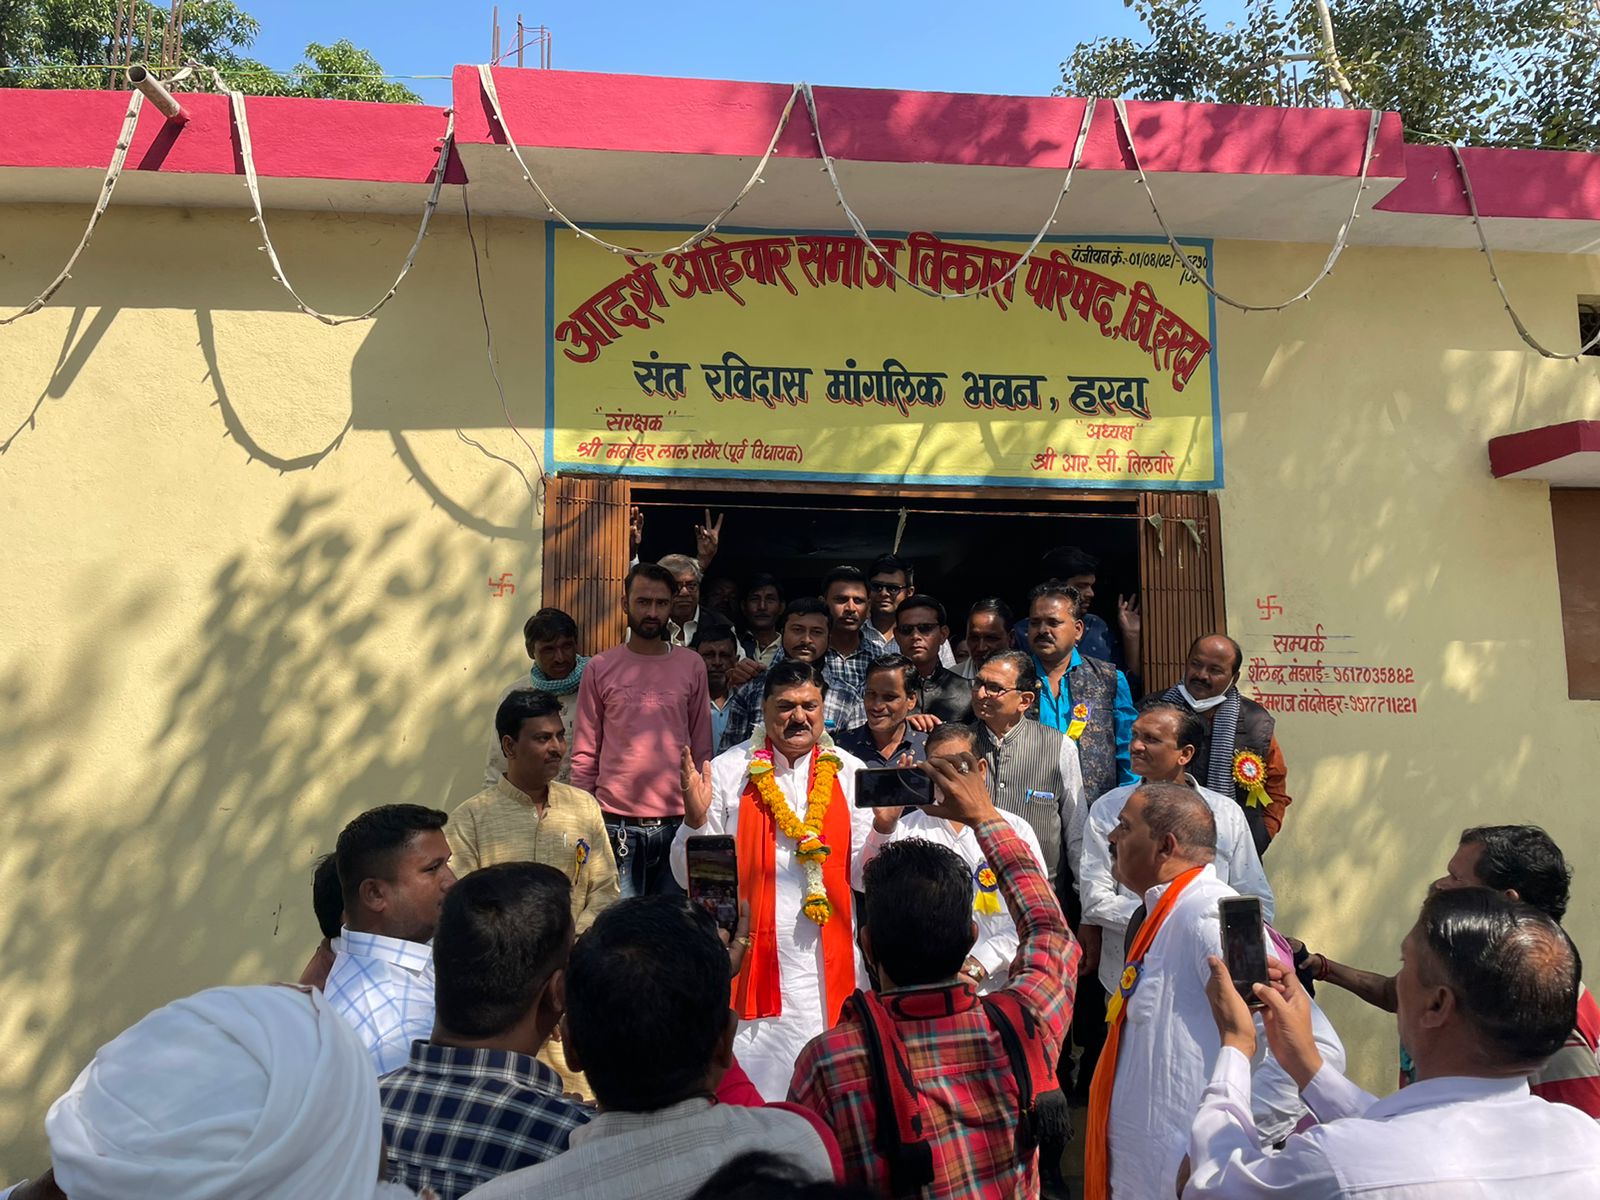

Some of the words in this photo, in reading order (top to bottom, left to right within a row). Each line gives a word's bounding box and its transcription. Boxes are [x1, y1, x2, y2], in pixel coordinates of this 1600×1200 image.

[555, 247, 670, 364] आदर्श
[795, 236, 905, 293] समाज
[906, 231, 1027, 312] विकास
[632, 350, 691, 400] संत
[700, 351, 814, 409] रविदास
[824, 358, 948, 417] मांगलिक
[1067, 375, 1152, 420] हरदा
[577, 436, 602, 458] श्री
[606, 436, 657, 462] मनोहर
[657, 444, 691, 460] लाल
[1031, 446, 1058, 471] श्री
[1272, 623, 1328, 655] सम्पर्क
